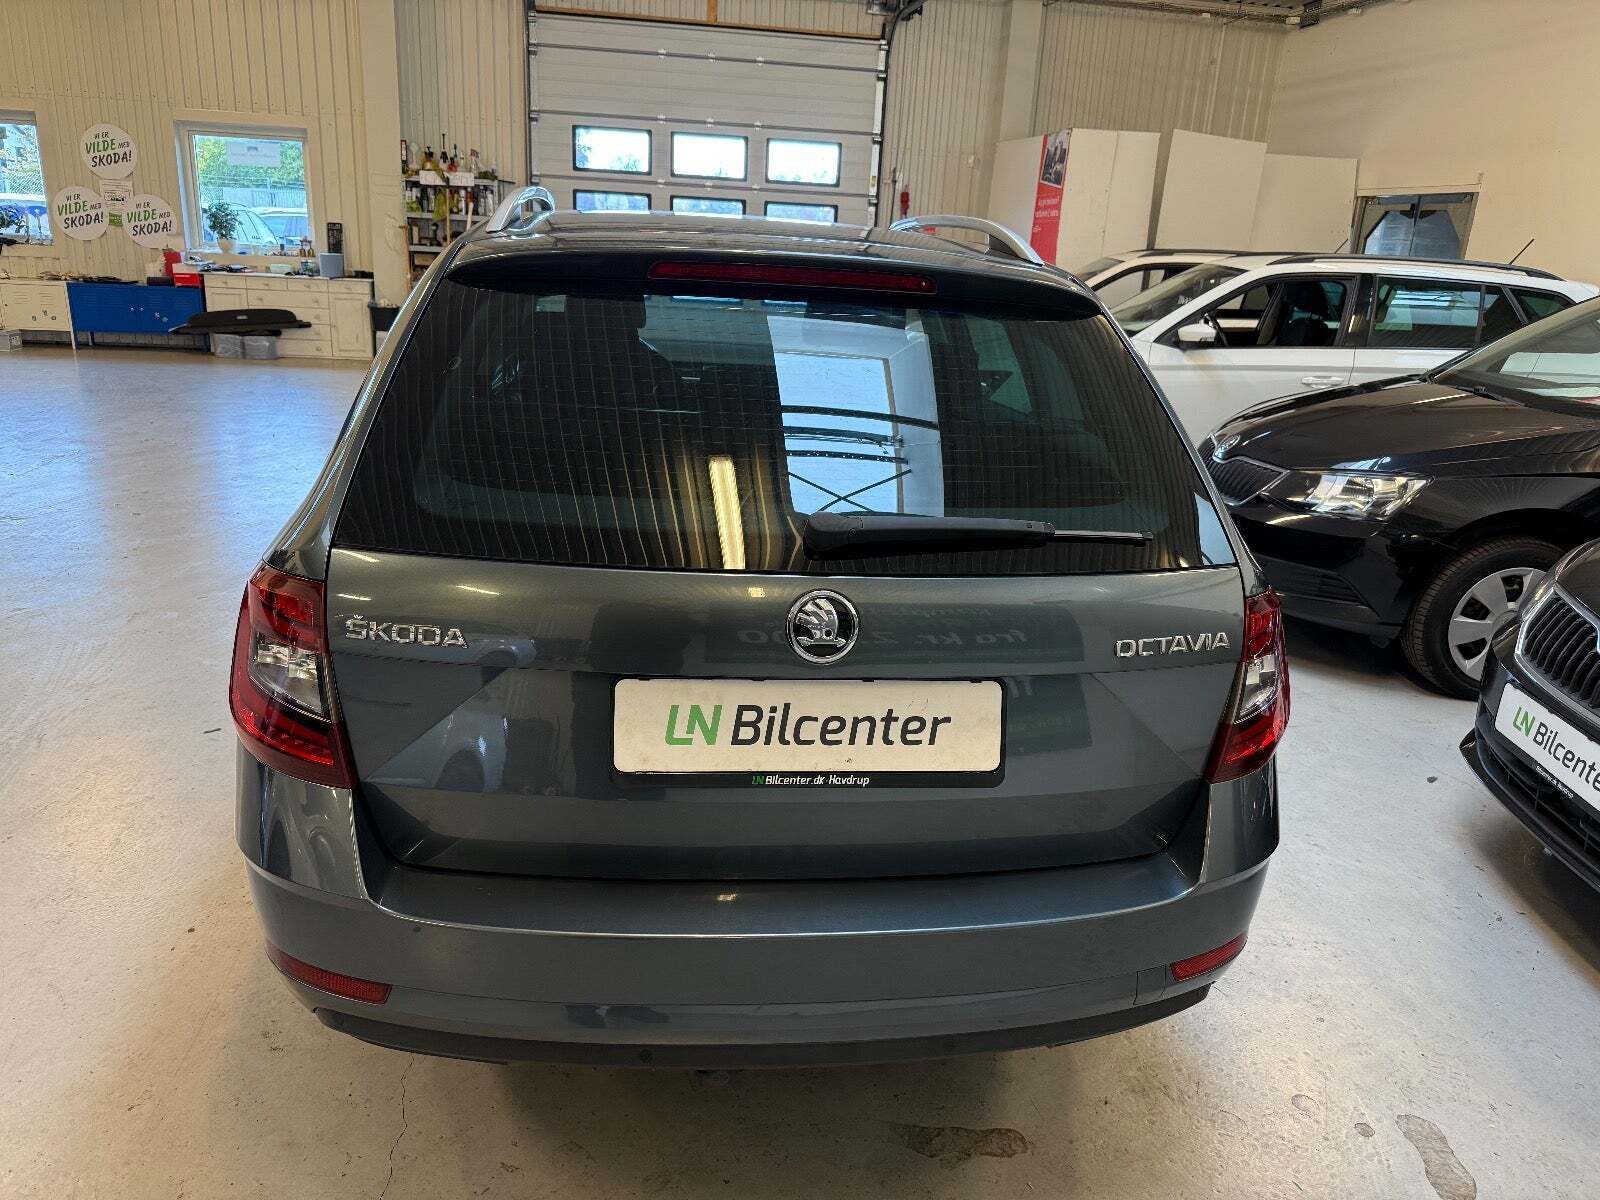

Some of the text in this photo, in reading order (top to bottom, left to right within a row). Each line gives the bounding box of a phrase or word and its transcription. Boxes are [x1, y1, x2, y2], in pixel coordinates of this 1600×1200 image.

[101, 131, 109, 139] ER
[85, 139, 130, 154] VILDE MED
[91, 150, 132, 168] SKODA!
[73, 193, 81, 201] ER
[143, 201, 151, 209] ER
[57, 200, 102, 216] VILDE MED
[126, 208, 157, 223] VILDE
[158, 211, 171, 219] MED
[63, 211, 104, 229] SKODA!
[132, 220, 172, 237] SKODA!
[1114, 632, 1230, 657] OCTAVIA
[664, 702, 951, 746] LN Bilcenter
[1512, 706, 1535, 737] LN
[828, 774, 870, 787] Havdrup
